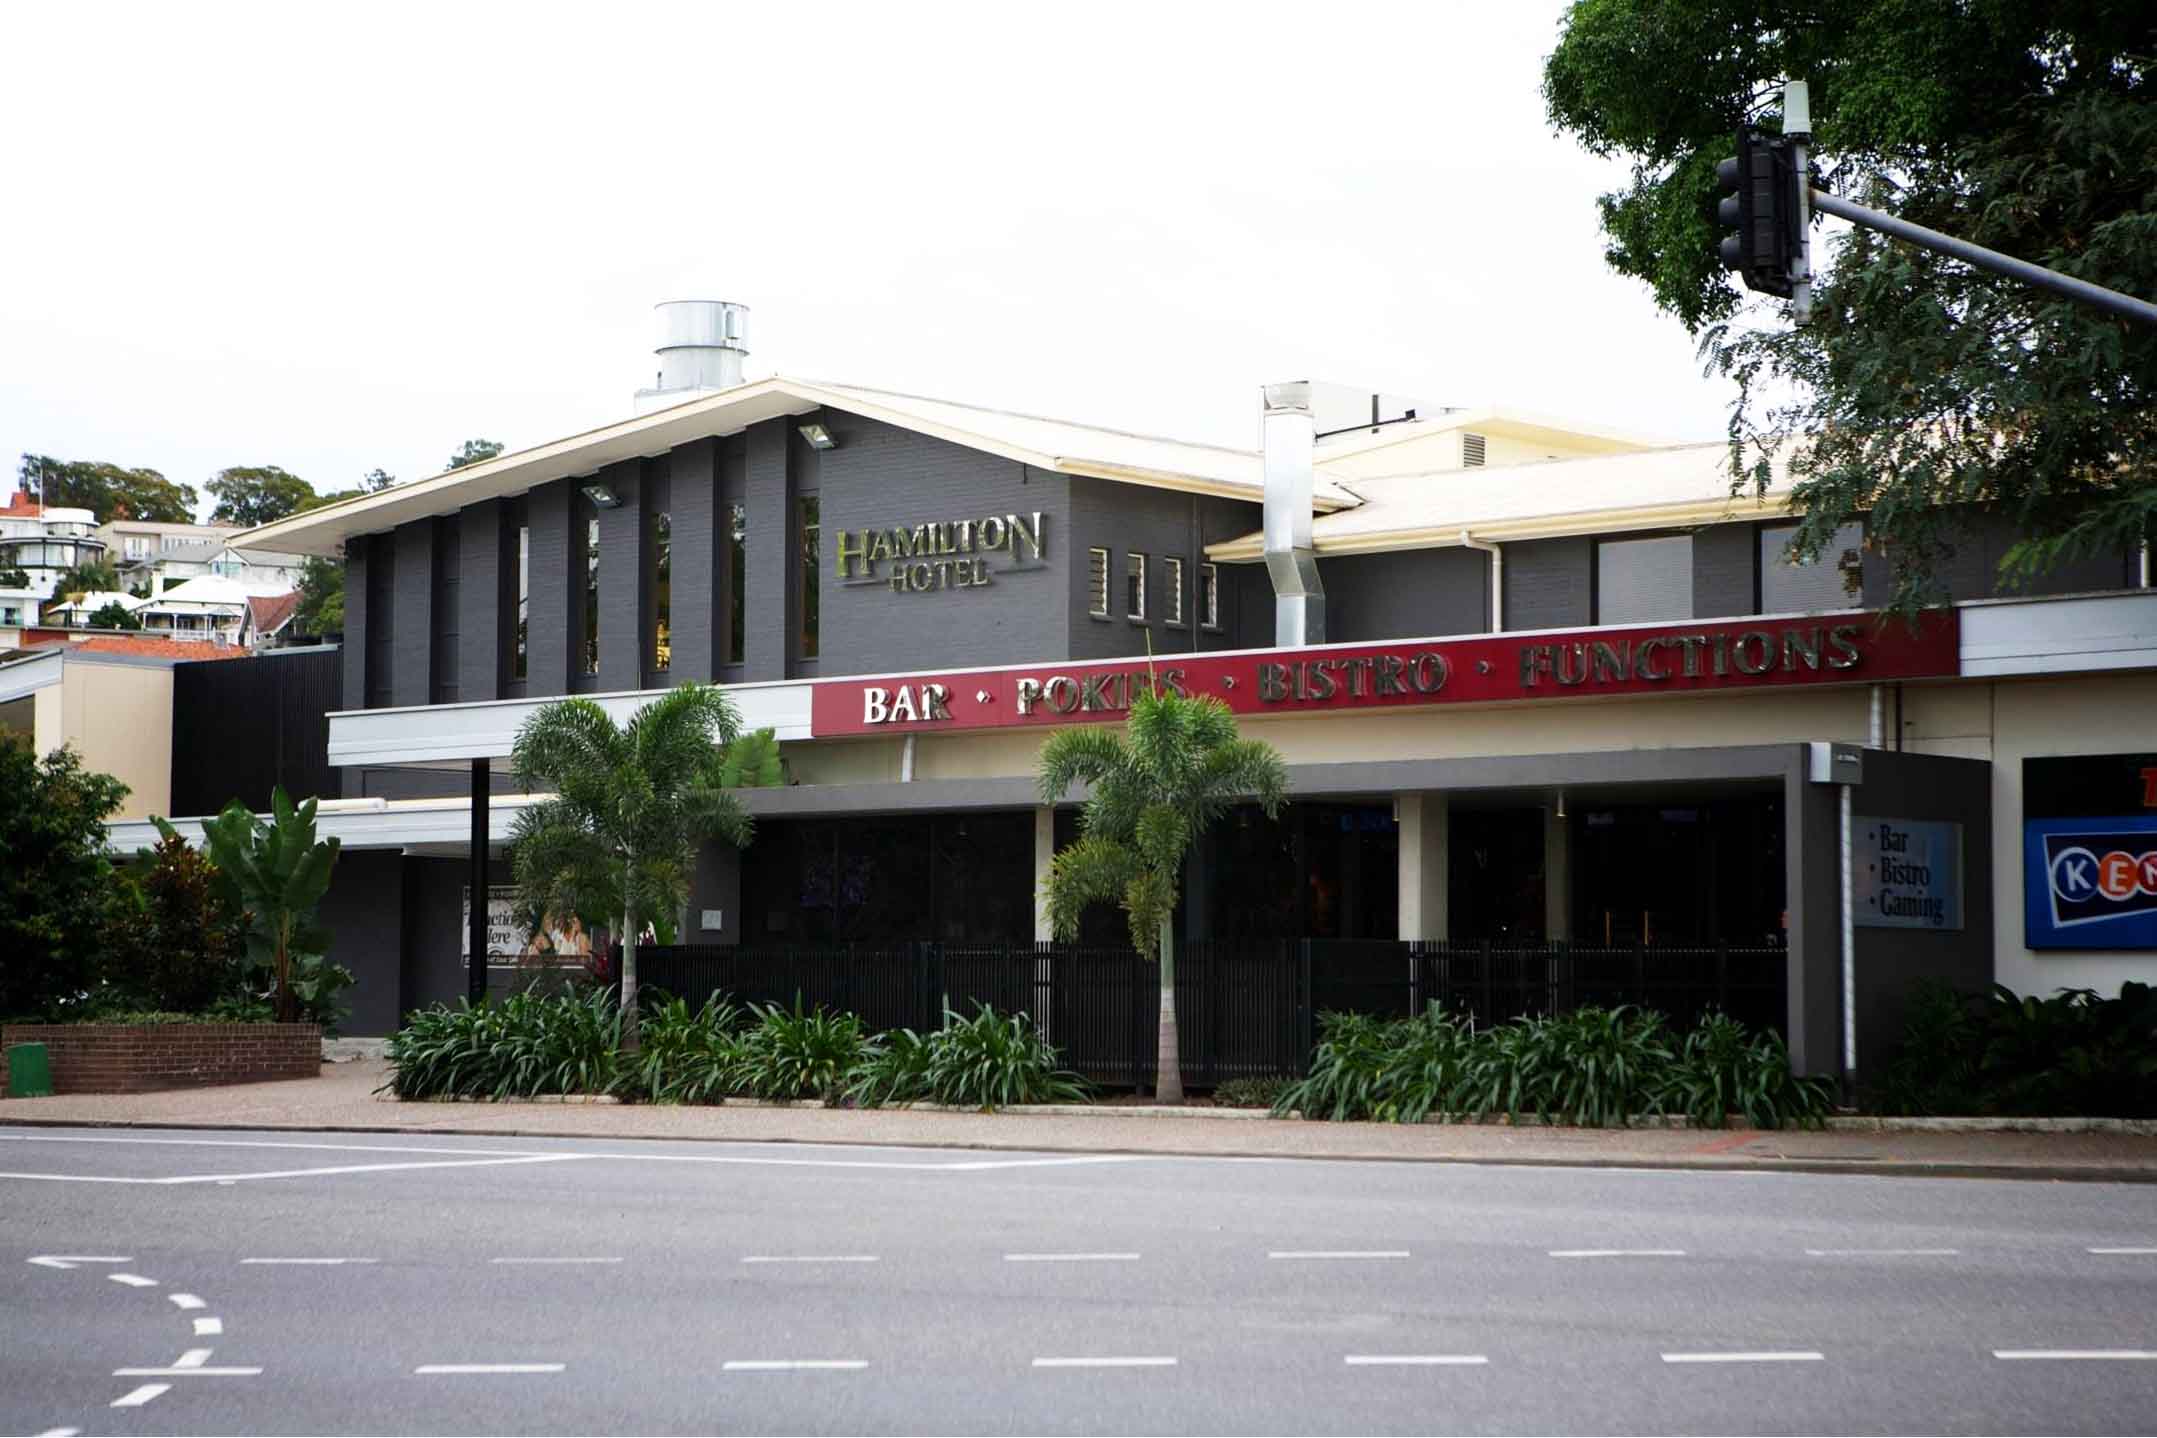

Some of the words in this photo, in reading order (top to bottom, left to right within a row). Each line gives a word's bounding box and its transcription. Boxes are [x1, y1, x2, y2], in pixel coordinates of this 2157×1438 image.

[836, 511, 1044, 577] HAMILTON
[888, 557, 993, 592] HOTEL
[862, 682, 952, 724] BAR
[1256, 651, 1449, 703] BISTRO
[1519, 624, 1864, 690] FUNCTIONS
[1879, 824, 1909, 853] Bar
[1880, 855, 1931, 886] Bistro
[1879, 888, 1945, 926] Gaming
